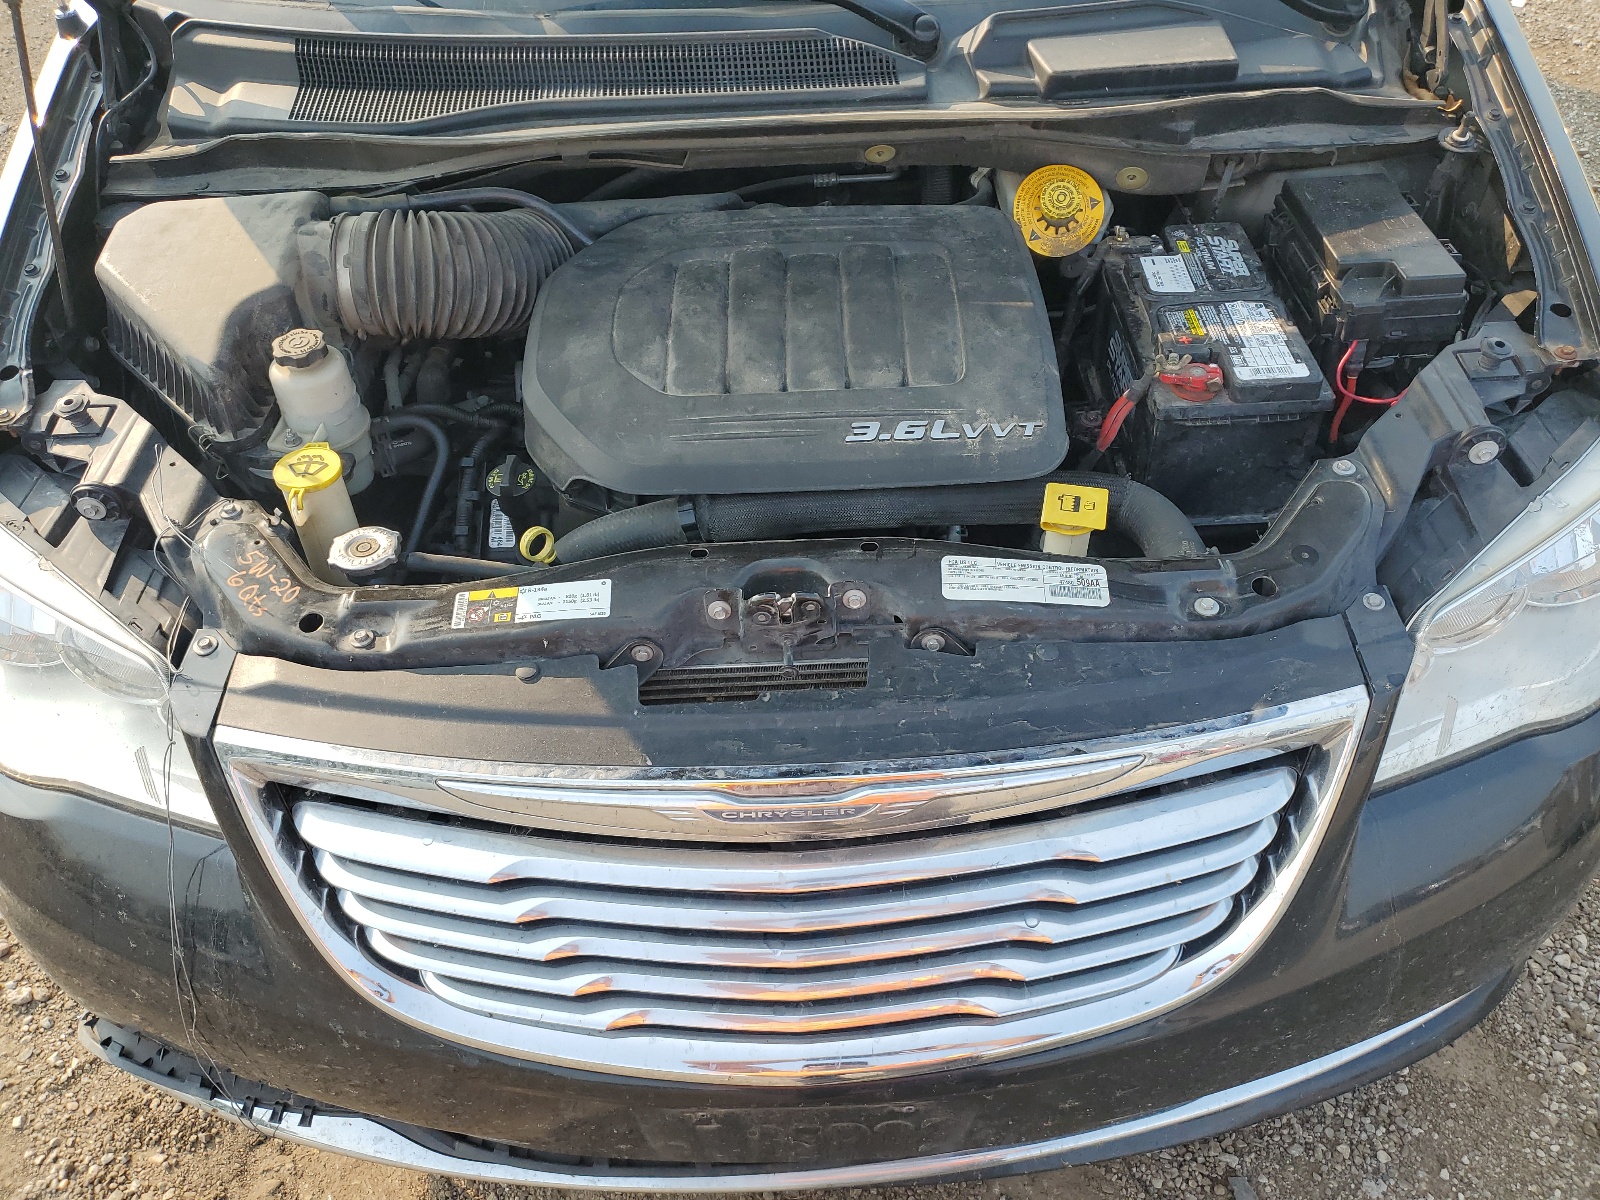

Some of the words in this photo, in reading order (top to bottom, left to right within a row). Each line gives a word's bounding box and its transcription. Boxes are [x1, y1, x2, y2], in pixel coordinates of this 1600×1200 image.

[1207, 236, 1235, 277] START
[1224, 239, 1250, 277] SUPER
[238, 550, 301, 603] 5W-20
[1076, 578, 1101, 588] 509AA
[721, 807, 856, 819] CHRYSLER
